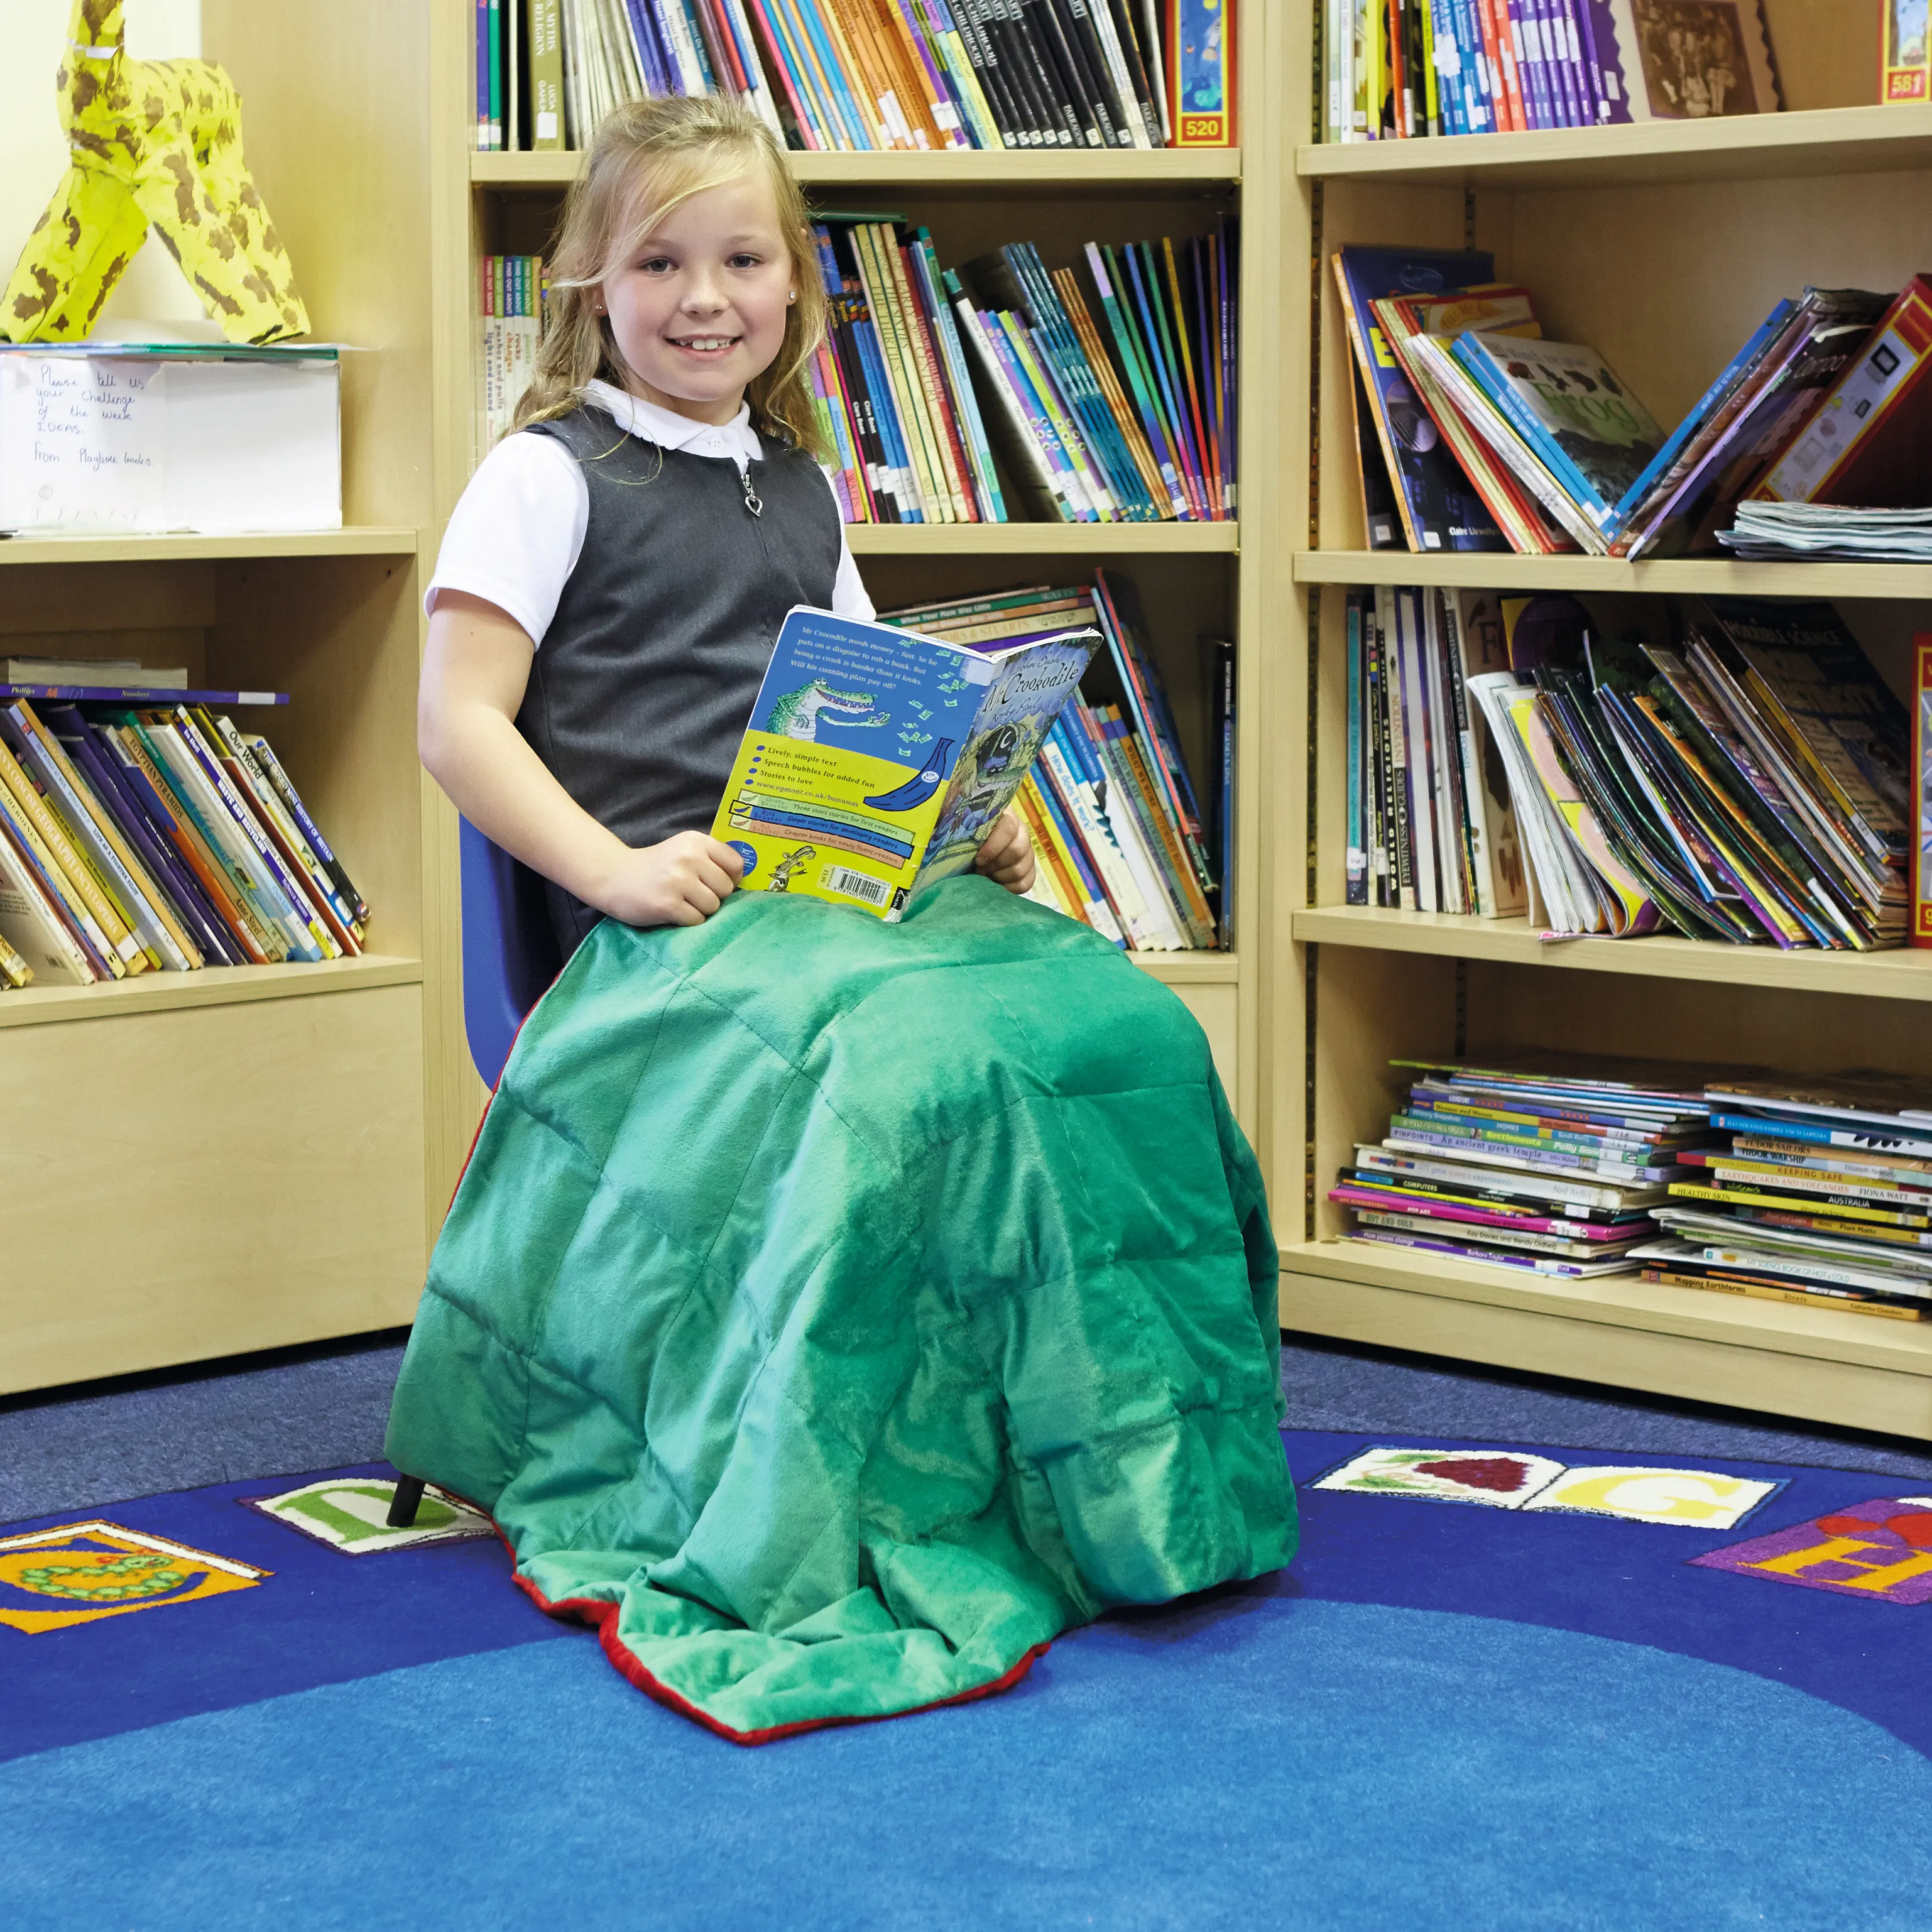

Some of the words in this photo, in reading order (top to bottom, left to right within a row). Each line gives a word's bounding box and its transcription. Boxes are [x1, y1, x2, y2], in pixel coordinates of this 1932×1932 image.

[535, 4, 545, 56] RELIGION
[547, 13, 555, 50] MYTHS
[954, 4, 983, 65] CHILDHOOD
[968, 3, 998, 65] CHILDHOOD
[1095, 103, 1117, 143] PARRAGON
[1140, 102, 1158, 145] PARRAGON
[1186, 121, 1218, 136] 520
[893, 310, 910, 349] SIXTIES
[484, 332, 494, 356] light
[880, 314, 902, 373] THIRTIES
[953, 341, 963, 361] Tudor
[915, 315, 932, 350] TUDOR
[925, 352, 946, 402] CHILDREN
[41, 364, 79, 388] Please
[97, 370, 117, 388] tell
[129, 376, 146, 390] us
[915, 347, 936, 403] CENTURY
[994, 366, 1006, 382] Pond
[36, 389, 64, 406] your
[496, 385, 504, 410] pulls
[38, 406, 49, 420] of
[70, 406, 89, 418] the
[102, 408, 133, 421] week
[1013, 405, 1027, 423] David
[79, 448, 118, 471] Playtime
[1449, 527, 1469, 537] Claire
[814, 630, 847, 642] Crocodile
[848, 638, 868, 647] needs
[870, 643, 894, 654] money
[794, 649, 814, 659] being
[851, 661, 875, 673] harder
[876, 669, 893, 677] than
[832, 645, 861, 657] disguise
[871, 655, 883, 663] rob
[914, 665, 926, 674] But
[1446, 613, 1458, 671] EYEWITNESS
[1455, 691, 1465, 727] GUIDES
[791, 660, 805, 668] Will
[819, 665, 848, 679] cunning
[849, 674, 866, 683] plan
[868, 678, 881, 687] pay
[1001, 660, 1079, 704] Crookodile
[11, 686, 36, 696] Phillips
[1391, 695, 1404, 763] INVENTION
[227, 729, 245, 750] Our
[240, 750, 264, 779] World
[768, 747, 792, 758] Lively,
[794, 753, 820, 763] simple
[822, 758, 837, 767] text
[1383, 718, 1394, 816] RELIGIONS
[760, 770, 785, 780] Stories
[797, 777, 813, 785] love
[763, 758, 790, 769] Speech
[792, 764, 821, 775] bubbles
[837, 774, 860, 784] added
[861, 780, 875, 789] fun
[757, 782, 859, 807] www.egmont.co.uk/bananas
[1049, 753, 1066, 775] How
[1059, 773, 1077, 797] does
[1075, 805, 1096, 834] work?
[1396, 770, 1405, 805] GUIDES
[6, 797, 38, 844] HEROINES
[215, 778, 236, 805] WASTE
[231, 802, 245, 819] AND
[240, 816, 268, 854] RECYCLING
[269, 763, 288, 790] OXFORD
[285, 788, 298, 805] MINI
[294, 803, 314, 829] HISTORY
[315, 836, 334, 862] BRITAIN
[794, 804, 810, 812] Three
[812, 808, 827, 816] short
[829, 810, 849, 821] stories
[851, 816, 861, 824] for
[861, 819, 873, 827] first
[875, 824, 898, 836] readers
[129, 738, 159, 780] EGYPTIAN
[155, 777, 185, 818] PYRAMIDS
[235, 897, 253, 920] Anne
[248, 917, 263, 936] Steel
[787, 816, 806, 824] Simple
[808, 819, 829, 828] stories
[841, 826, 872, 841] developing
[873, 836, 898, 849] readers
[9, 769, 38, 809] CONCISE
[33, 805, 79, 870] GEOGRAPHY
[72, 866, 120, 935] ENCYCLOPEDIA
[784, 829, 808, 839] Chapter
[809, 834, 826, 842] books
[828, 837, 838, 845] for
[838, 839, 856, 850] newly
[856, 843, 873, 854] fluent
[873, 850, 898, 864] readers
[1388, 828, 1397, 890] WORLD
[1399, 823, 1410, 884] EYEWITNESS
[275, 856, 292, 880] Powell
[1487, 1131, 1541, 1146] Settlements
[1497, 1123, 1519, 1132] HOMES
[1394, 1130, 1434, 1142] PINPOINTS
[1455, 1139, 1485, 1149] ancient
[1488, 1143, 1510, 1153] greek
[1514, 1145, 1542, 1159] temple
[1553, 1142, 1577, 1154] Polly
[1744, 1139, 1774, 1149] TUDOR
[1777, 1143, 1811, 1154] SAILORS
[1771, 1152, 1806, 1164] WARSHIP
[1404, 1181, 1438, 1192] COMPUTERS
[1722, 1171, 1780, 1186] EARTHQUAKES
[1782, 1178, 1799, 1187] AND
[1801, 1181, 1849, 1193] VOLCANOES
[1777, 1166, 1817, 1178] KEEPING
[1822, 1171, 1842, 1181] SAFE
[1554, 1185, 1568, 1194] Neil
[1570, 1188, 1593, 1200] Ardley
[1677, 1188, 1711, 1199] HEALTHY
[1713, 1192, 1730, 1201] SKIN
[1828, 1196, 1870, 1208] AUSTRALIA
[1859, 1188, 1884, 1198] FIONA
[1889, 1192, 1909, 1201] WATT
[1364, 1231, 1376, 1240] How
[1377, 1234, 1394, 1243] places
[1395, 1237, 1414, 1247] change
[1467, 1230, 1478, 1238] Kay
[1480, 1231, 1499, 1240] Davies
[1514, 1236, 1533, 1247] Wendy
[1467, 1249, 1488, 1258] Barbara
[1489, 1252, 1505, 1262] Taylor
[1759, 1260, 1781, 1269] SCIENCE
[1782, 1263, 1802, 1273] BOOK
[1812, 1269, 1827, 1278] HOT
[1832, 1273, 1850, 1282] COLD
[1675, 1276, 1704, 1289] Mapping
[1706, 1280, 1746, 1294] Earthforms
[1784, 1293, 1807, 1303] Rivers
[1554, 1473, 1747, 1521] G
